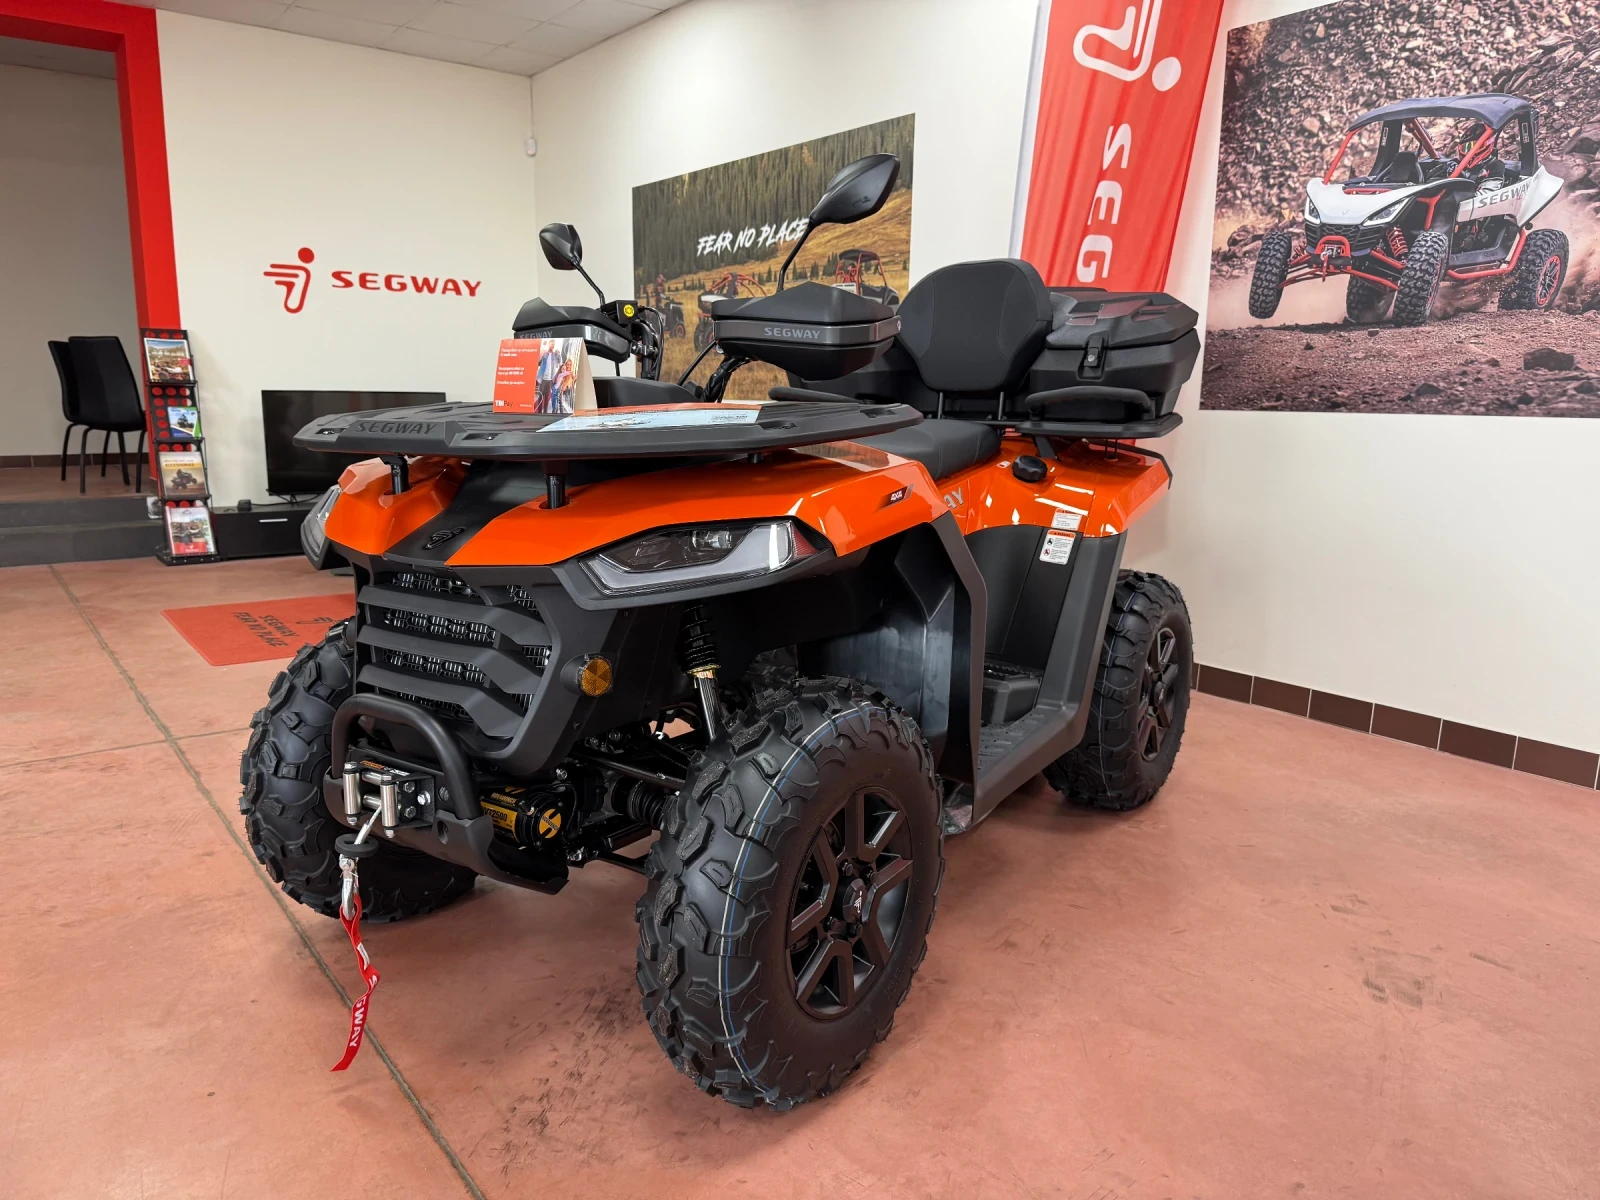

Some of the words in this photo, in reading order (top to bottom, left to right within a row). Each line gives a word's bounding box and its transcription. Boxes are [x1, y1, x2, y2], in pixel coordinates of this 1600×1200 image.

[1477, 182, 1530, 209] SEGWAY
[696, 229, 733, 257] FEAR
[733, 226, 756, 254] NO
[757, 217, 810, 248] PLACE
[331, 270, 482, 297] SEGWAY
[764, 327, 820, 339] SEGWAY
[354, 421, 438, 435] SEGWAY
